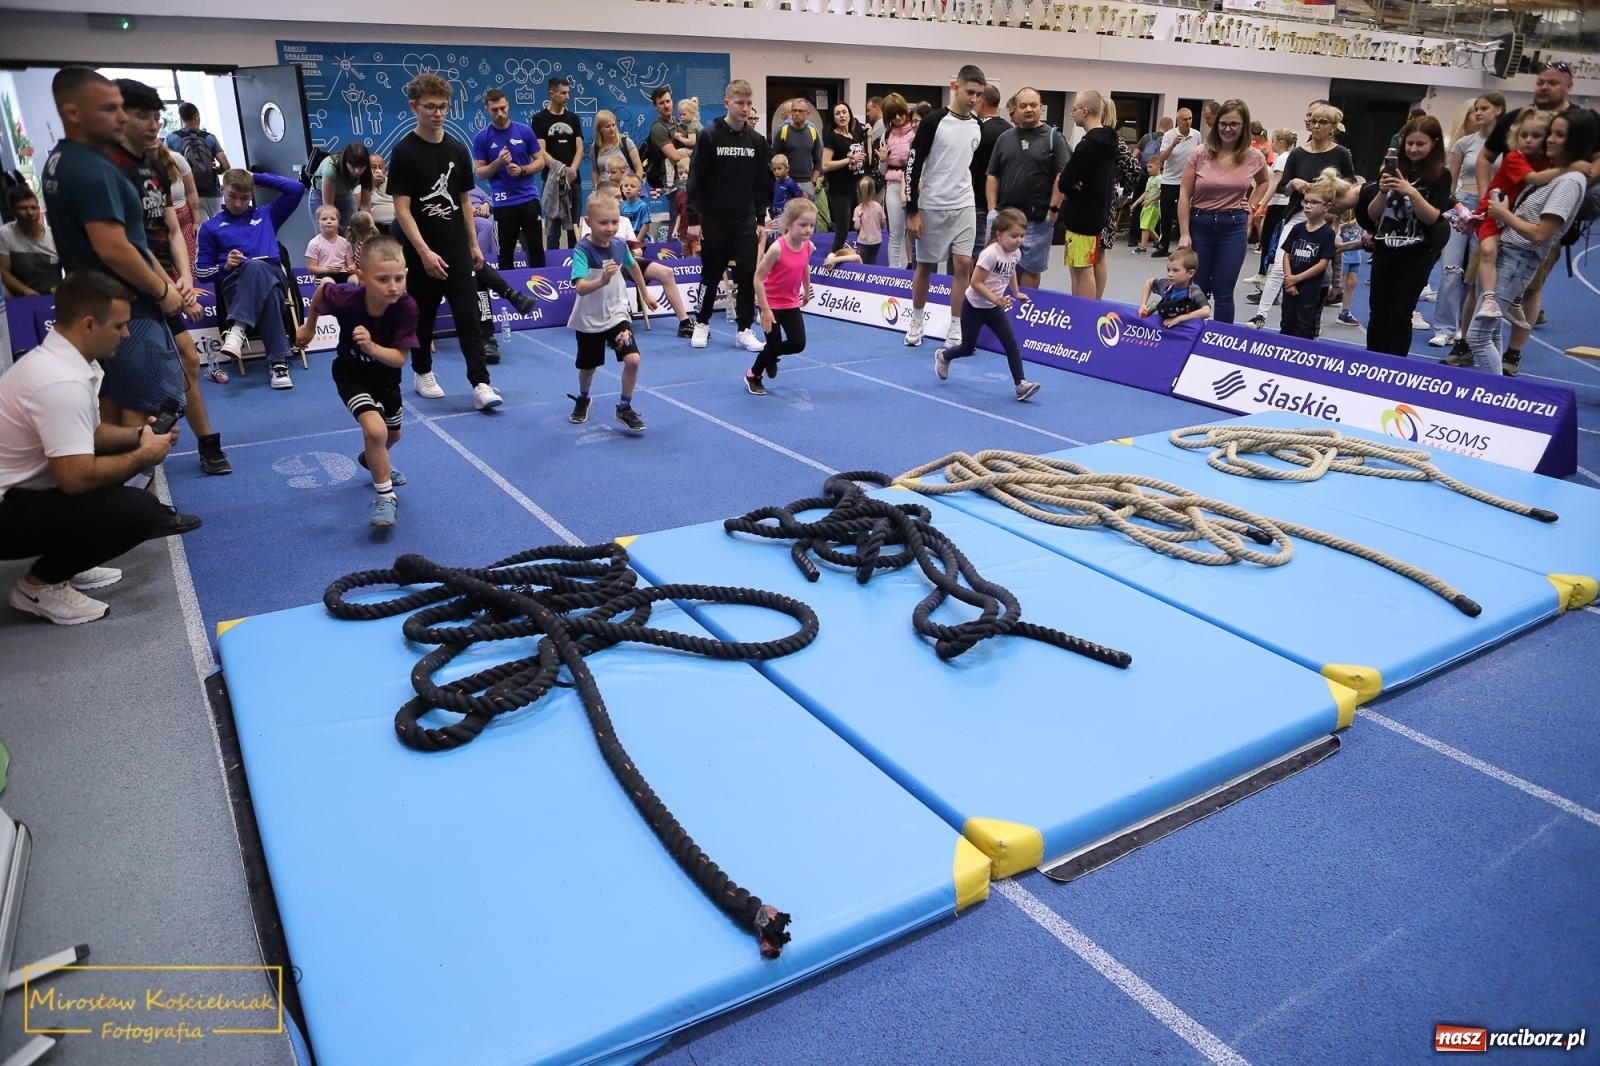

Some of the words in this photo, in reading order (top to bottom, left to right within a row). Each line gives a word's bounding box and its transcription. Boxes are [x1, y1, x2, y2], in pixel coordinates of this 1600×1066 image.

[495, 192, 507, 201] 25
[817, 266, 866, 283] MISTRZOSTWA
[818, 290, 862, 314] Śląskie.
[1016, 300, 1072, 330] Śląskie.
[1123, 324, 1162, 342] ZSOMS
[1023, 339, 1091, 364] smsraciborz.pl
[1202, 331, 1248, 353] SZKOŁA
[1249, 341, 1344, 374] MISTRZOSTWA
[1347, 362, 1453, 396] SPORTOWEGO
[1455, 385, 1470, 399] w
[1470, 387, 1559, 418] Raciborzu
[1425, 424, 1491, 451] ZSOMS
